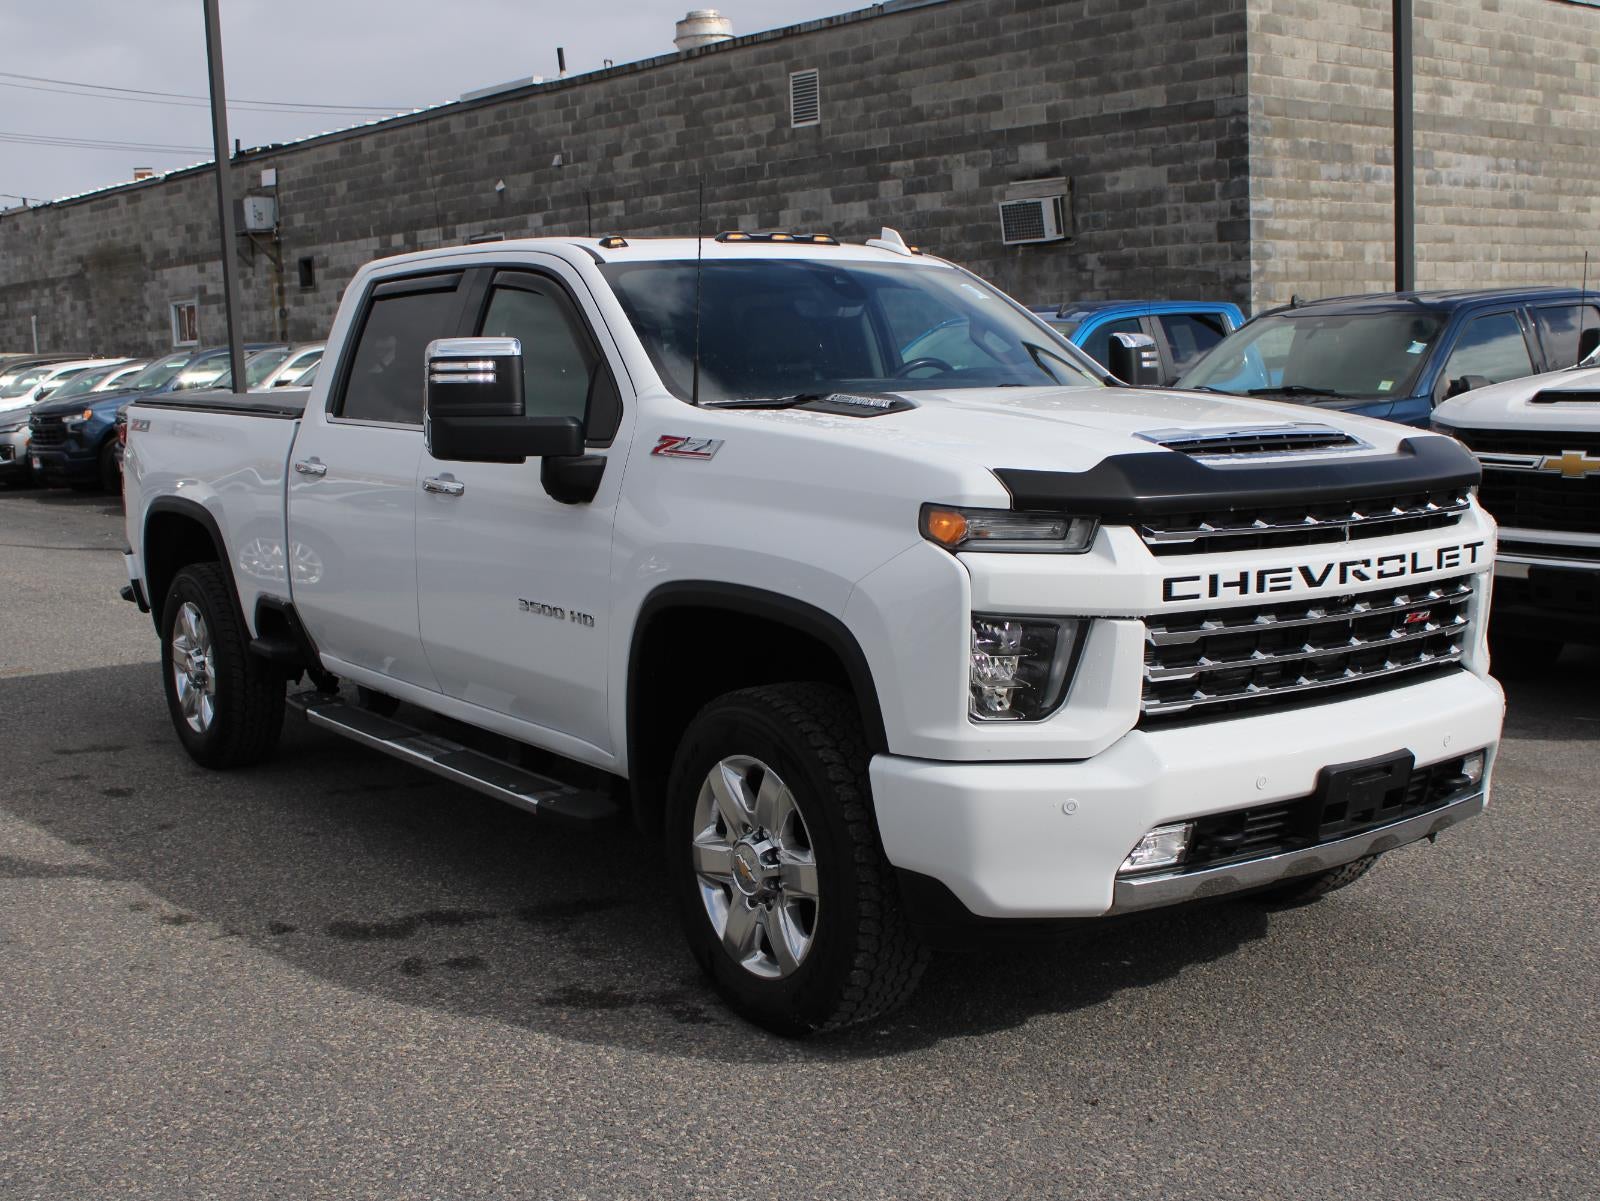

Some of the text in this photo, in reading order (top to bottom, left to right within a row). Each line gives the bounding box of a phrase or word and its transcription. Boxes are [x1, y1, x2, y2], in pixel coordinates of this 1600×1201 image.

[650, 434, 725, 461] Z71
[1162, 541, 1484, 602] CHEVROLET
[518, 598, 595, 627] 3500 HD
